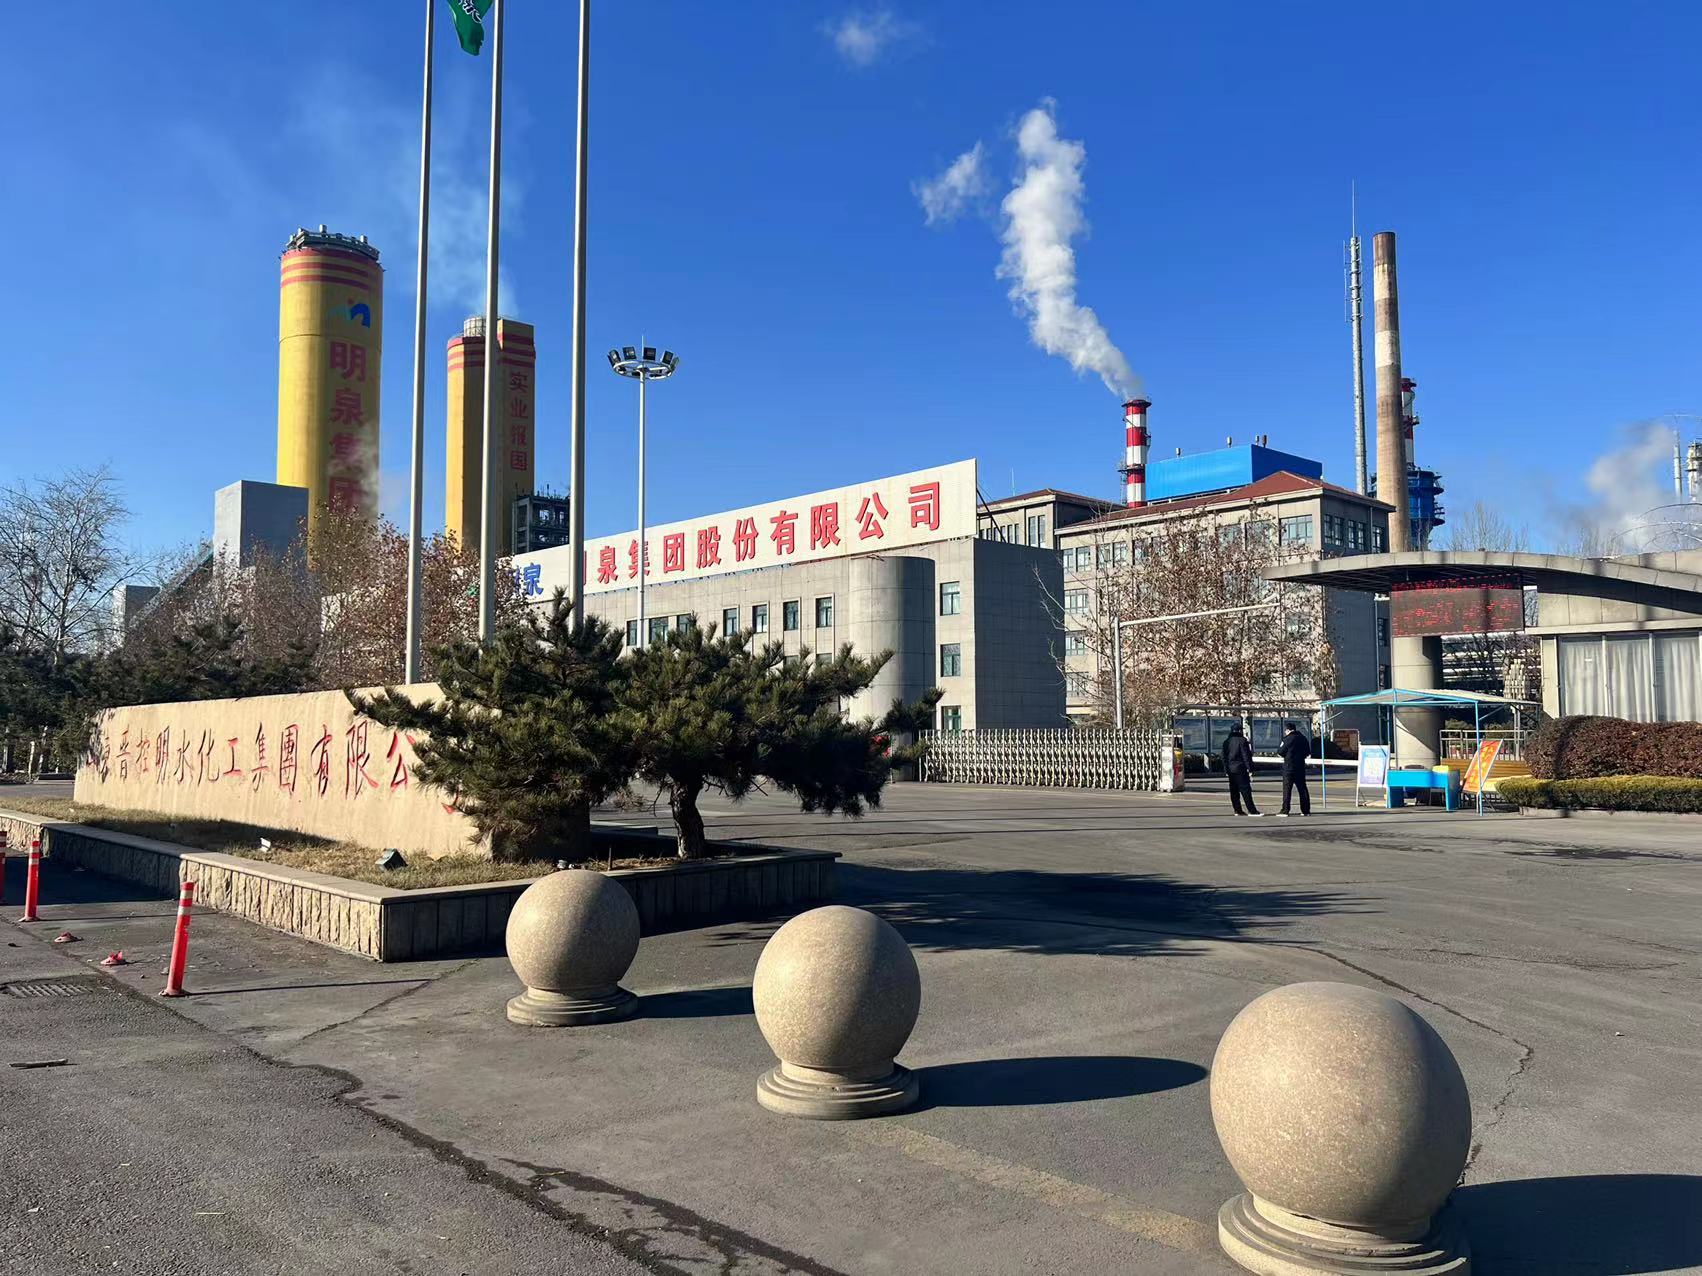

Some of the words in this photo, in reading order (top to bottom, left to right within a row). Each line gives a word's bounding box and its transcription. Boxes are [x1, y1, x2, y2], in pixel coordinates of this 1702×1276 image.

[510, 371, 529, 471] 实业报国
[583, 481, 940, 587] 泉集团股份有限公司
